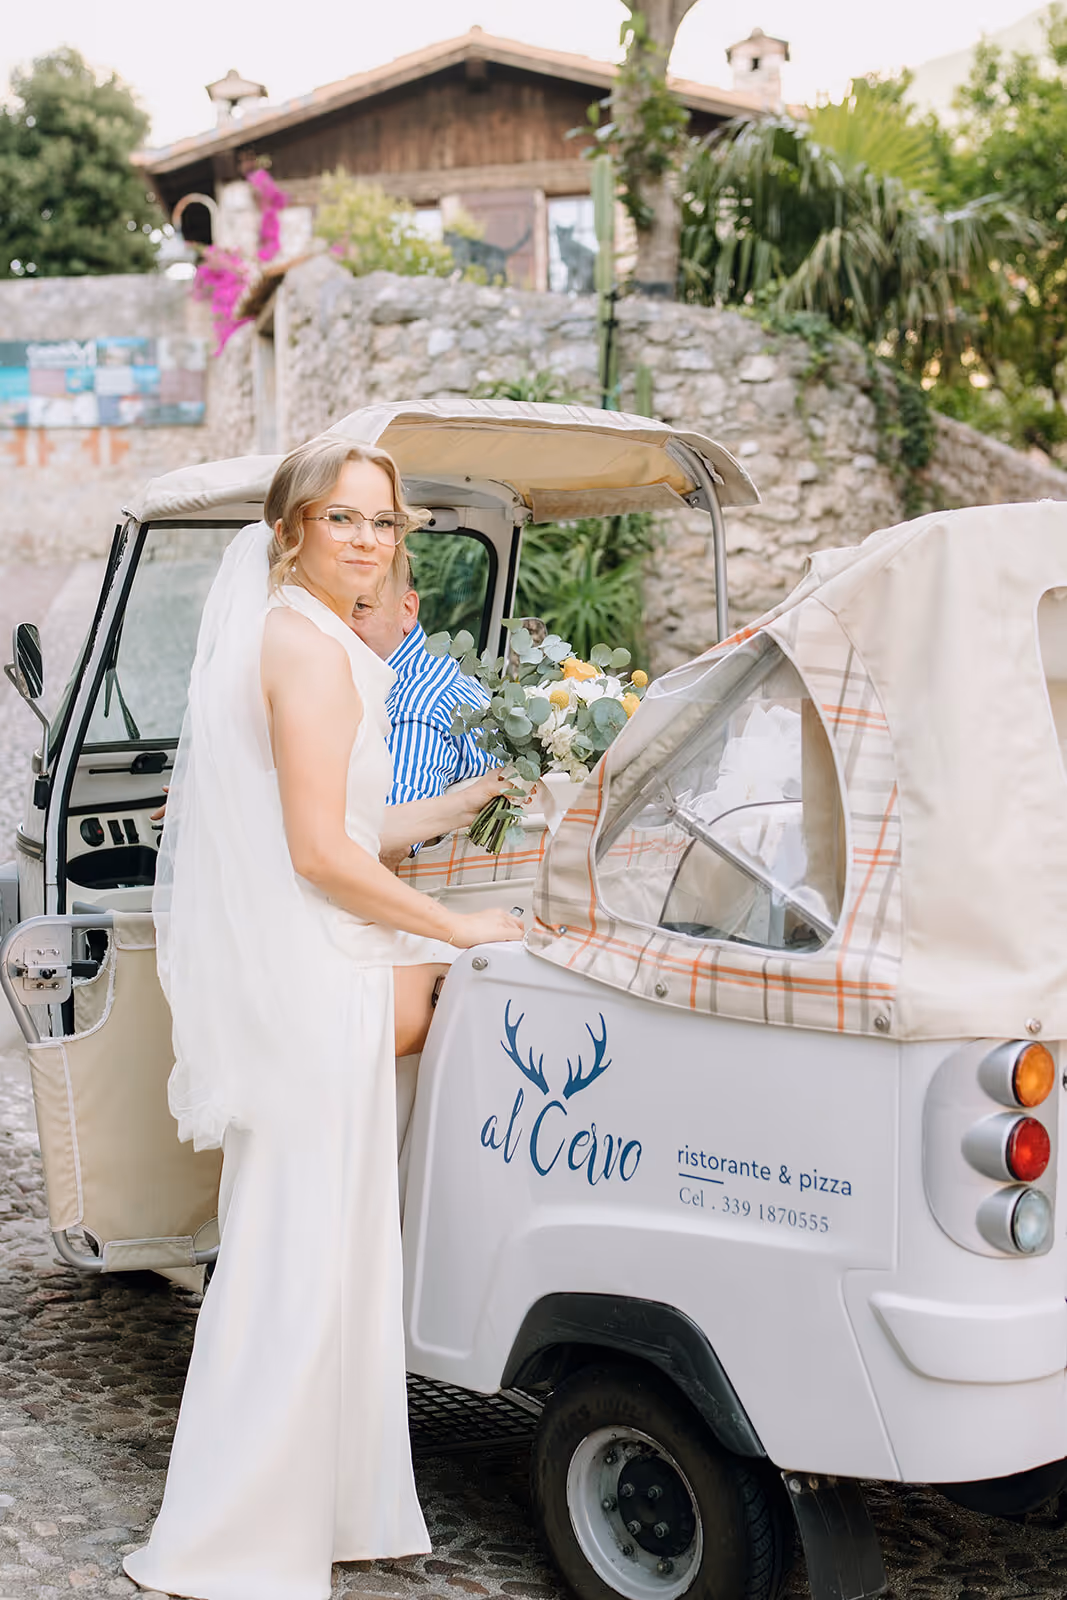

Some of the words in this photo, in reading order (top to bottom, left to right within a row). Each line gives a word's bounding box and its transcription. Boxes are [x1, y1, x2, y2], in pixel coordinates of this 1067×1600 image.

[480, 1087, 525, 1165] al
[529, 1099, 643, 1187] Cervo
[677, 1144, 772, 1182] ristorante
[778, 1164, 792, 1186] &
[799, 1168, 852, 1197] pizza
[721, 1195, 751, 1217] 339
[758, 1203, 829, 1234] 1870555
